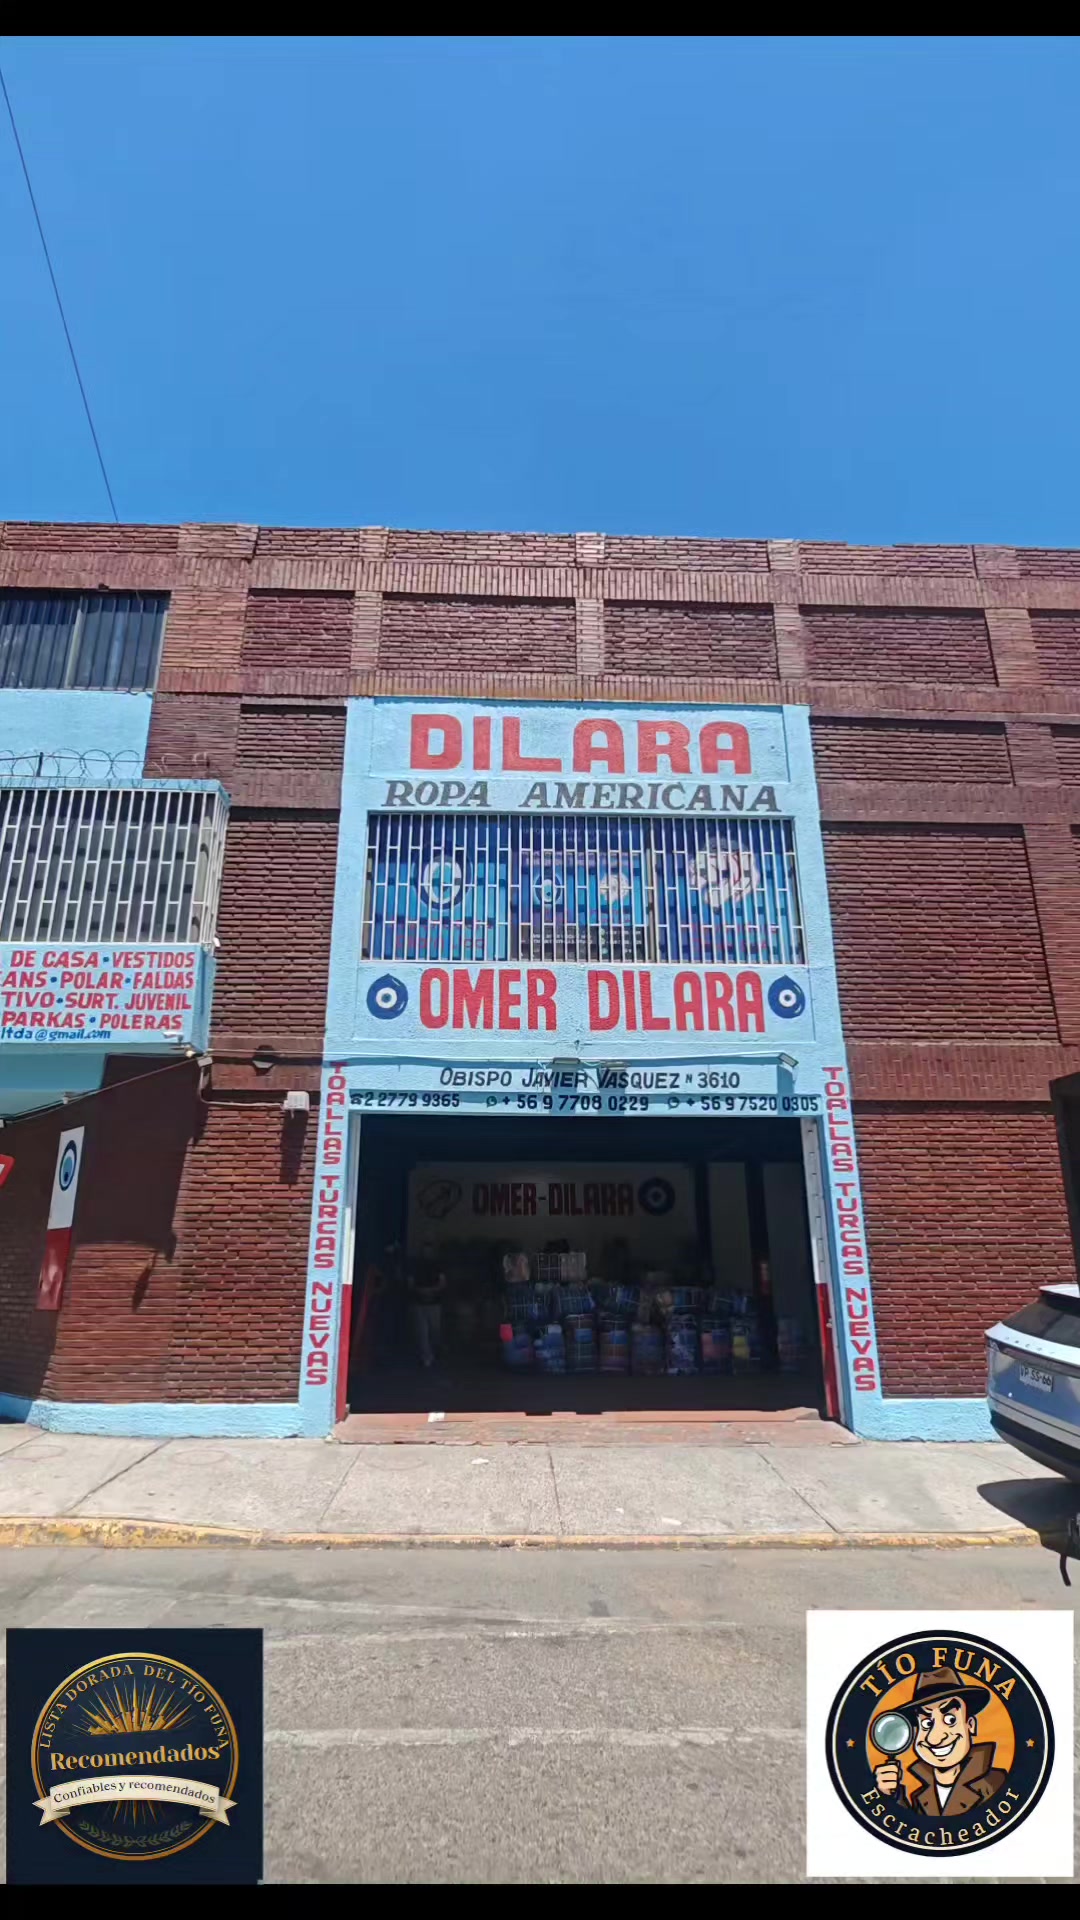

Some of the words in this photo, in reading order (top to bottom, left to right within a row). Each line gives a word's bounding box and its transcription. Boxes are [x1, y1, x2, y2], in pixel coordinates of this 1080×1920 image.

[410, 713, 752, 775] DILARA
[381, 780, 491, 809] ROPA
[519, 782, 783, 813] AMERICANA
[10, 950, 37, 968] DE
[42, 951, 99, 969] CASA
[112, 951, 195, 969] VESTIDOS
[60, 972, 124, 990] POLAR
[133, 972, 194, 989] FALDAS
[65, 993, 118, 1010] SURT.
[125, 993, 192, 1011] JUVENIL
[419, 968, 558, 1031] OMER
[588, 970, 766, 1033] DILARA
[1, 1011, 86, 1028] PARKAS
[100, 1013, 183, 1031] POLERAS
[439, 1067, 513, 1087] OBISPO
[521, 1067, 588, 1088] JAVIER
[598, 1068, 681, 1089] VASQUEZ
[697, 1071, 740, 1089] 3610
[322, 1061, 347, 1165] TOALLAS
[377, 1092, 418, 1107] 2779
[422, 1093, 460, 1108] 9365
[516, 1094, 538, 1109] 56
[543, 1095, 553, 1110] 9
[558, 1094, 603, 1111] 7708
[607, 1095, 649, 1111] 0229
[701, 1097, 721, 1112] 56
[726, 1097, 735, 1111] 9
[739, 1096, 777, 1112] 7520
[782, 1097, 818, 1112] 0305
[822, 1067, 855, 1172] TOALLAS
[472, 1182, 635, 1217] OMER-DILARA
[314, 1175, 340, 1269] TURCAS
[835, 1182, 864, 1276] TURCAS
[305, 1281, 333, 1386] NUEVAS
[846, 1287, 876, 1392] NUEVAS
